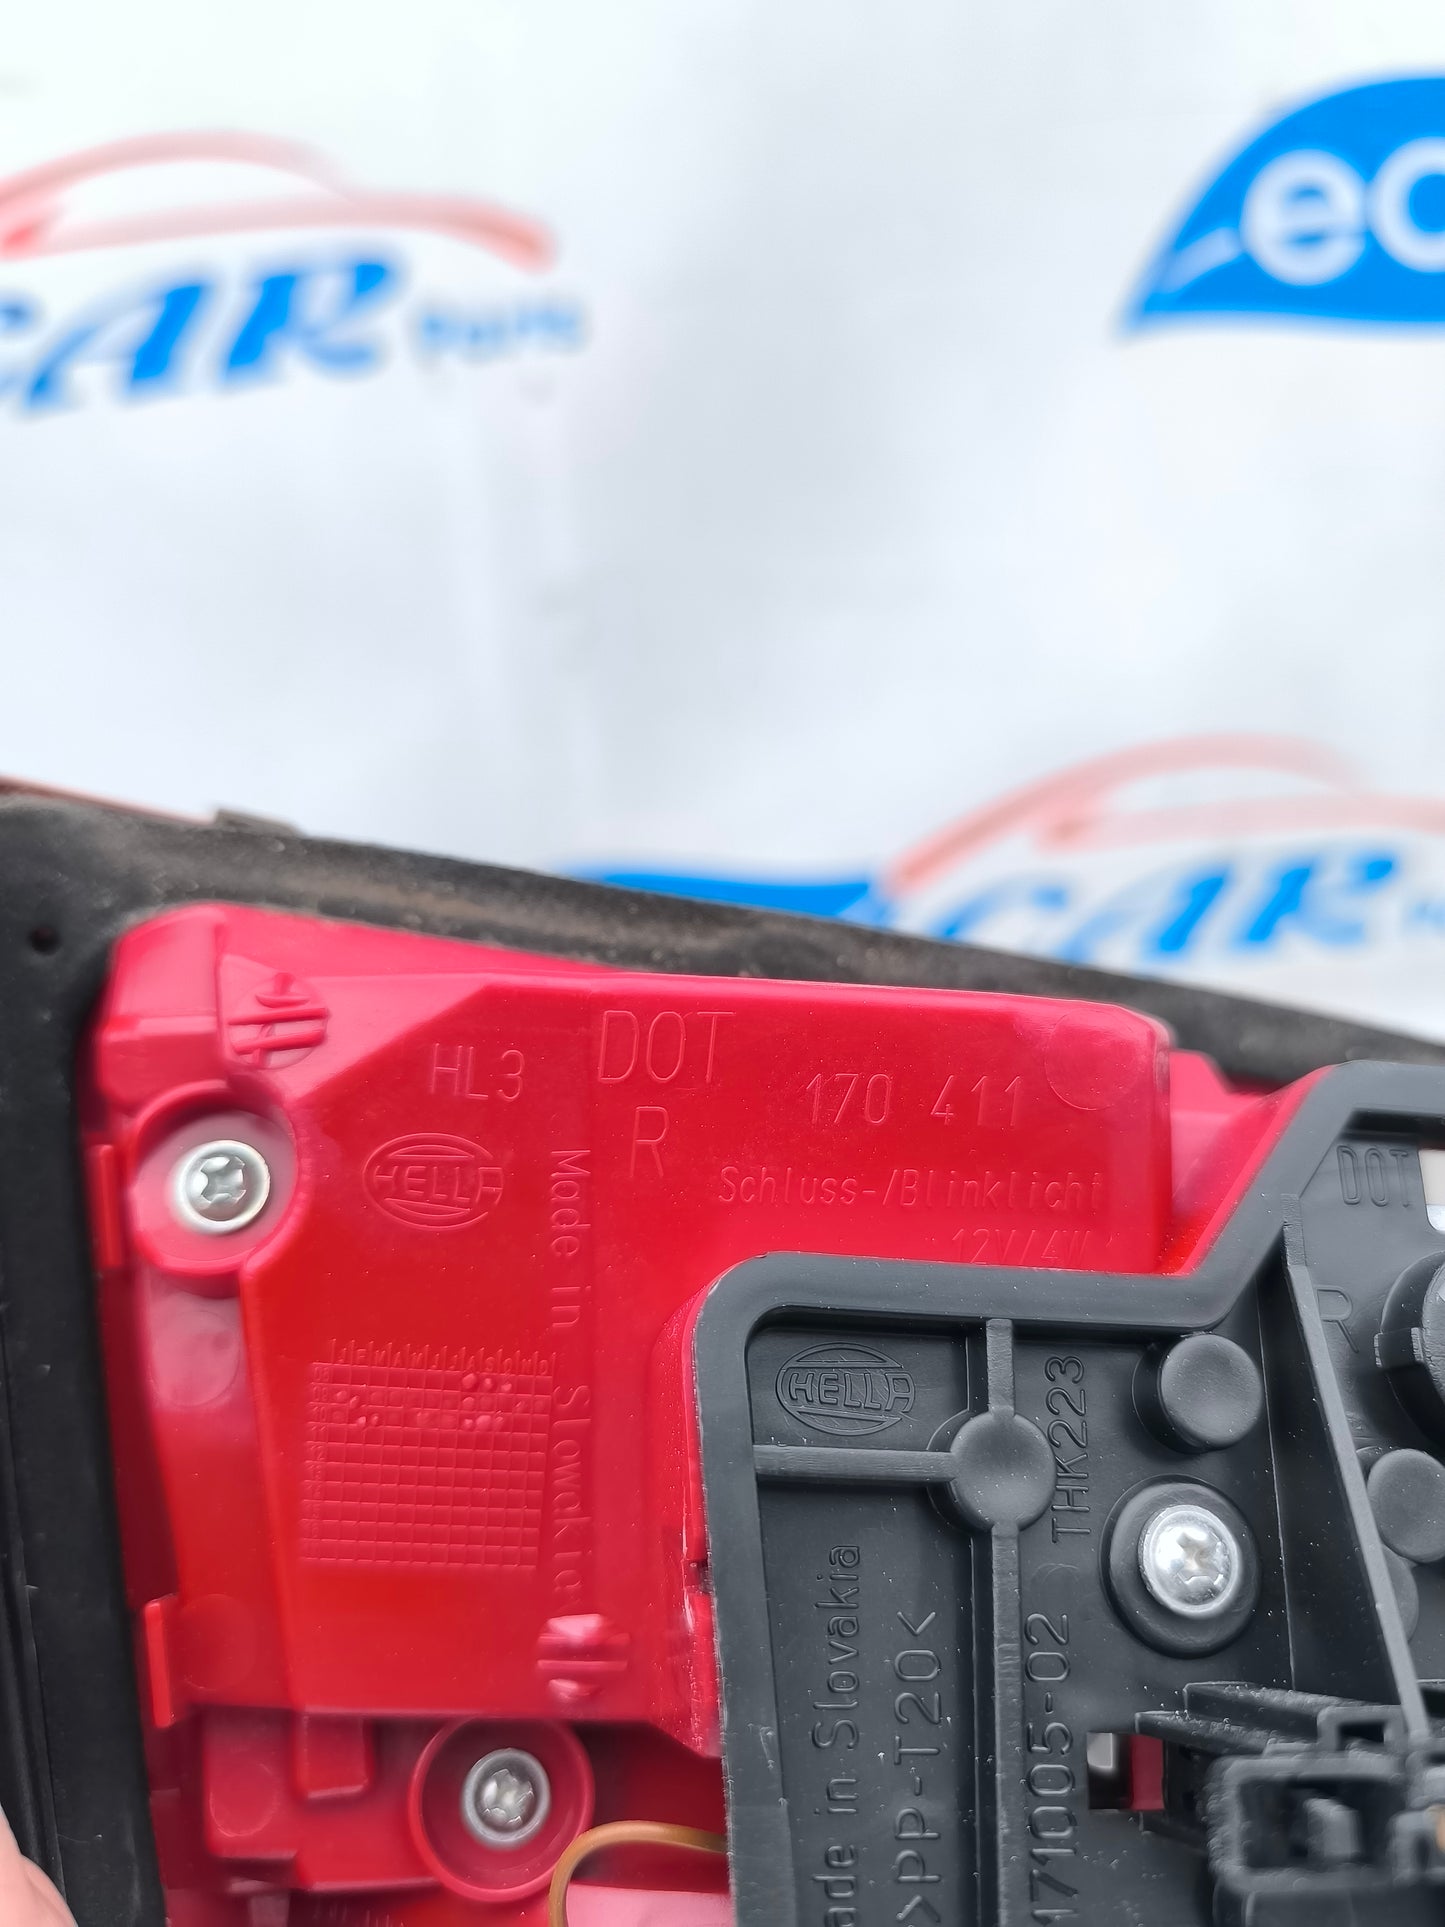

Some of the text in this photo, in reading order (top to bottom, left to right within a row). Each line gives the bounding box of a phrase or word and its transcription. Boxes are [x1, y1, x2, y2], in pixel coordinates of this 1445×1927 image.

[599, 1008, 736, 1084] DOT
[806, 1072, 1021, 1126] 170 411
[630, 1105, 669, 1178] R
[550, 1148, 592, 1258] Made
[1336, 1145, 1409, 1208] DOT
[550, 1285, 592, 1328] in
[1316, 1285, 1360, 1353] R
[789, 1371, 916, 1413] HELLA
[1045, 1355, 1091, 1543] THK223
[811, 1543, 859, 1750] Slovakia
[813, 1777, 858, 1815] in
